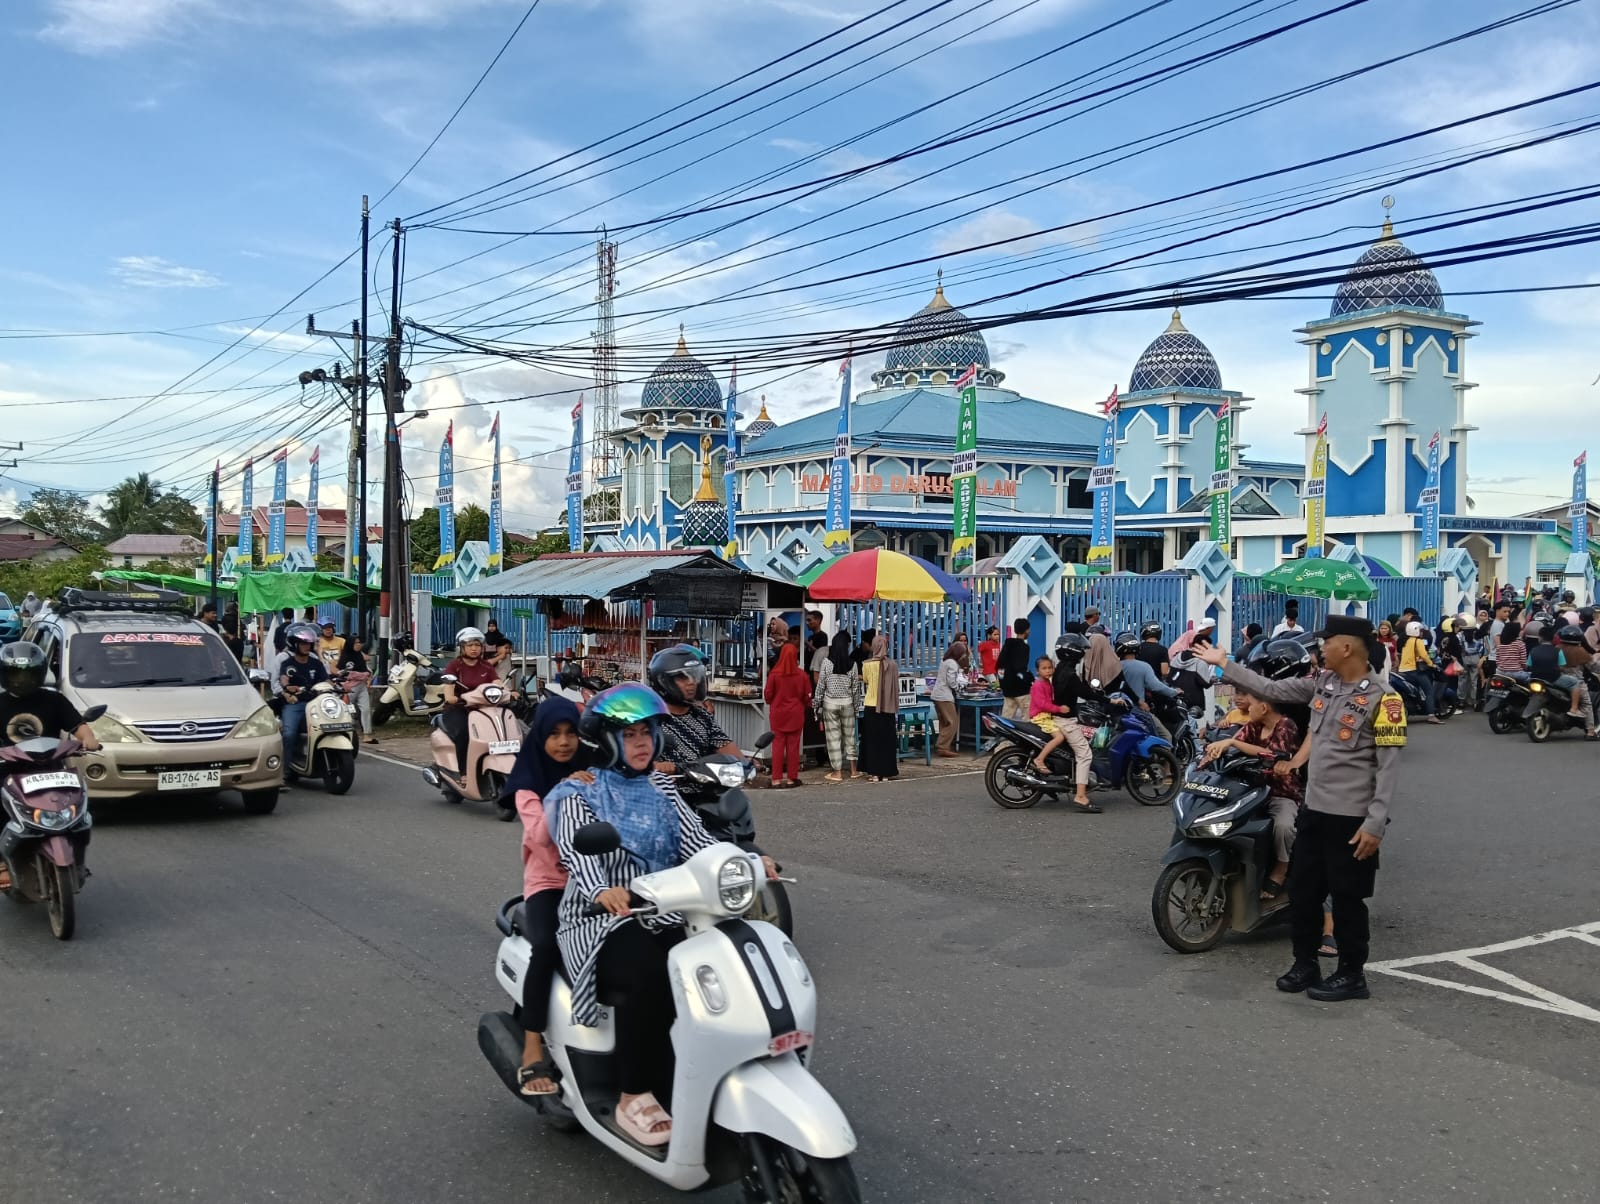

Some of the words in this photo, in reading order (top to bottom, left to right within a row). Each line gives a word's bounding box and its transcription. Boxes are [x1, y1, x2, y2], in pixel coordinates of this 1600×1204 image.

[953, 463, 974, 474] HILIR
[801, 474, 882, 492] MAJID
[890, 475, 1017, 497] DARUSALAM
[832, 465, 845, 530] DARUSSALAM
[1303, 568, 1327, 578] Sprite
[1344, 701, 1368, 717] POLRI
